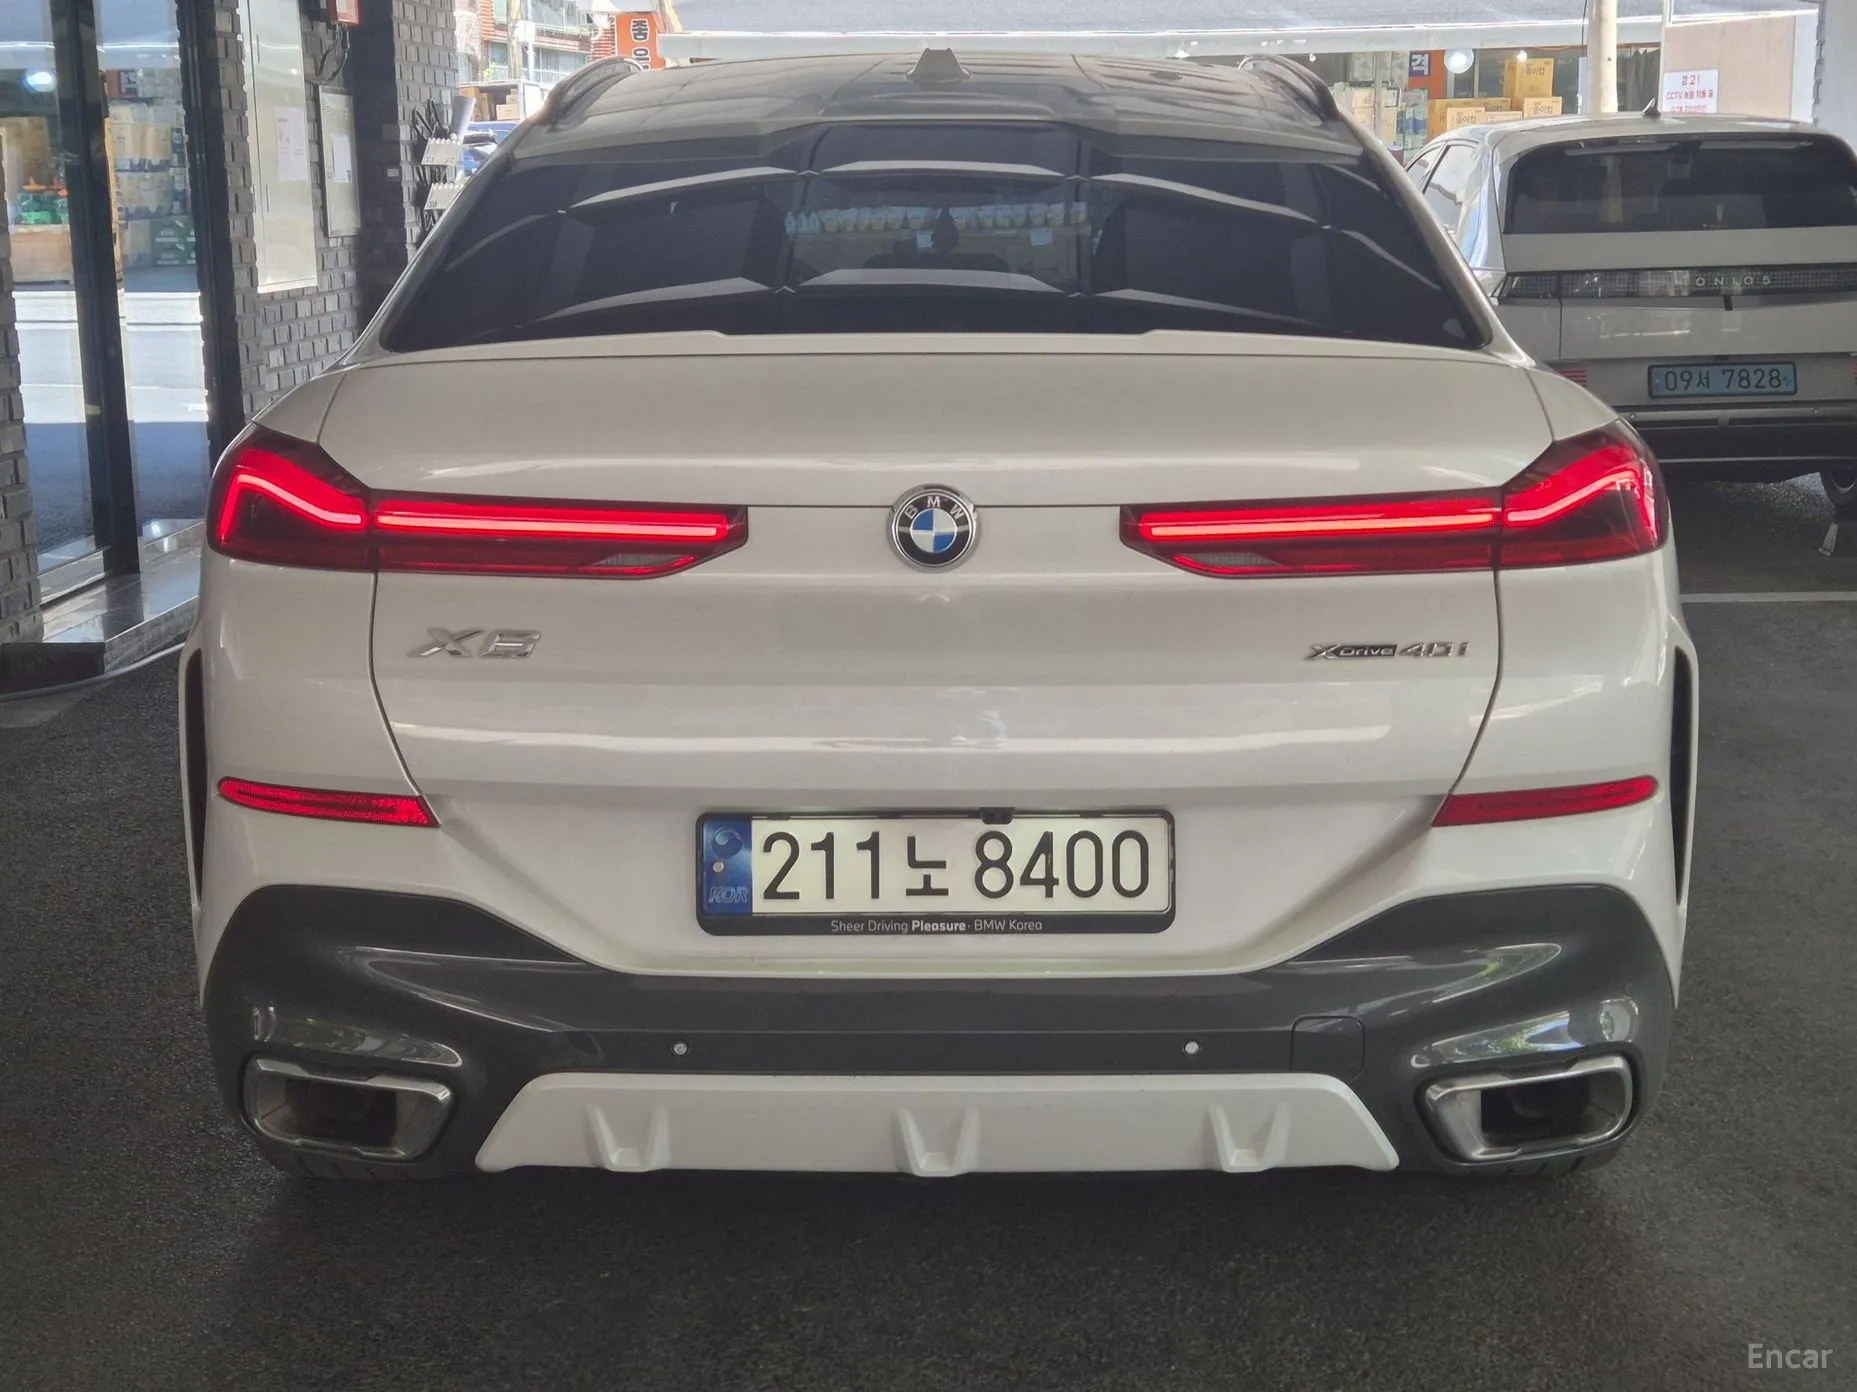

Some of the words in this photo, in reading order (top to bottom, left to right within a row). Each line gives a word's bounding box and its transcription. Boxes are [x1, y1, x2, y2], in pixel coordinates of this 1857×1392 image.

[1664, 369, 1710, 391] 09서
[1721, 368, 1782, 389] 7828
[904, 496, 965, 520] BMW
[974, 830, 1149, 898] 8400
[709, 886, 748, 904] KOR
[831, 920, 865, 932] Sheer
[868, 920, 908, 934] Driving
[974, 919, 1005, 931] BMW
[1009, 919, 1043, 931] Korea
